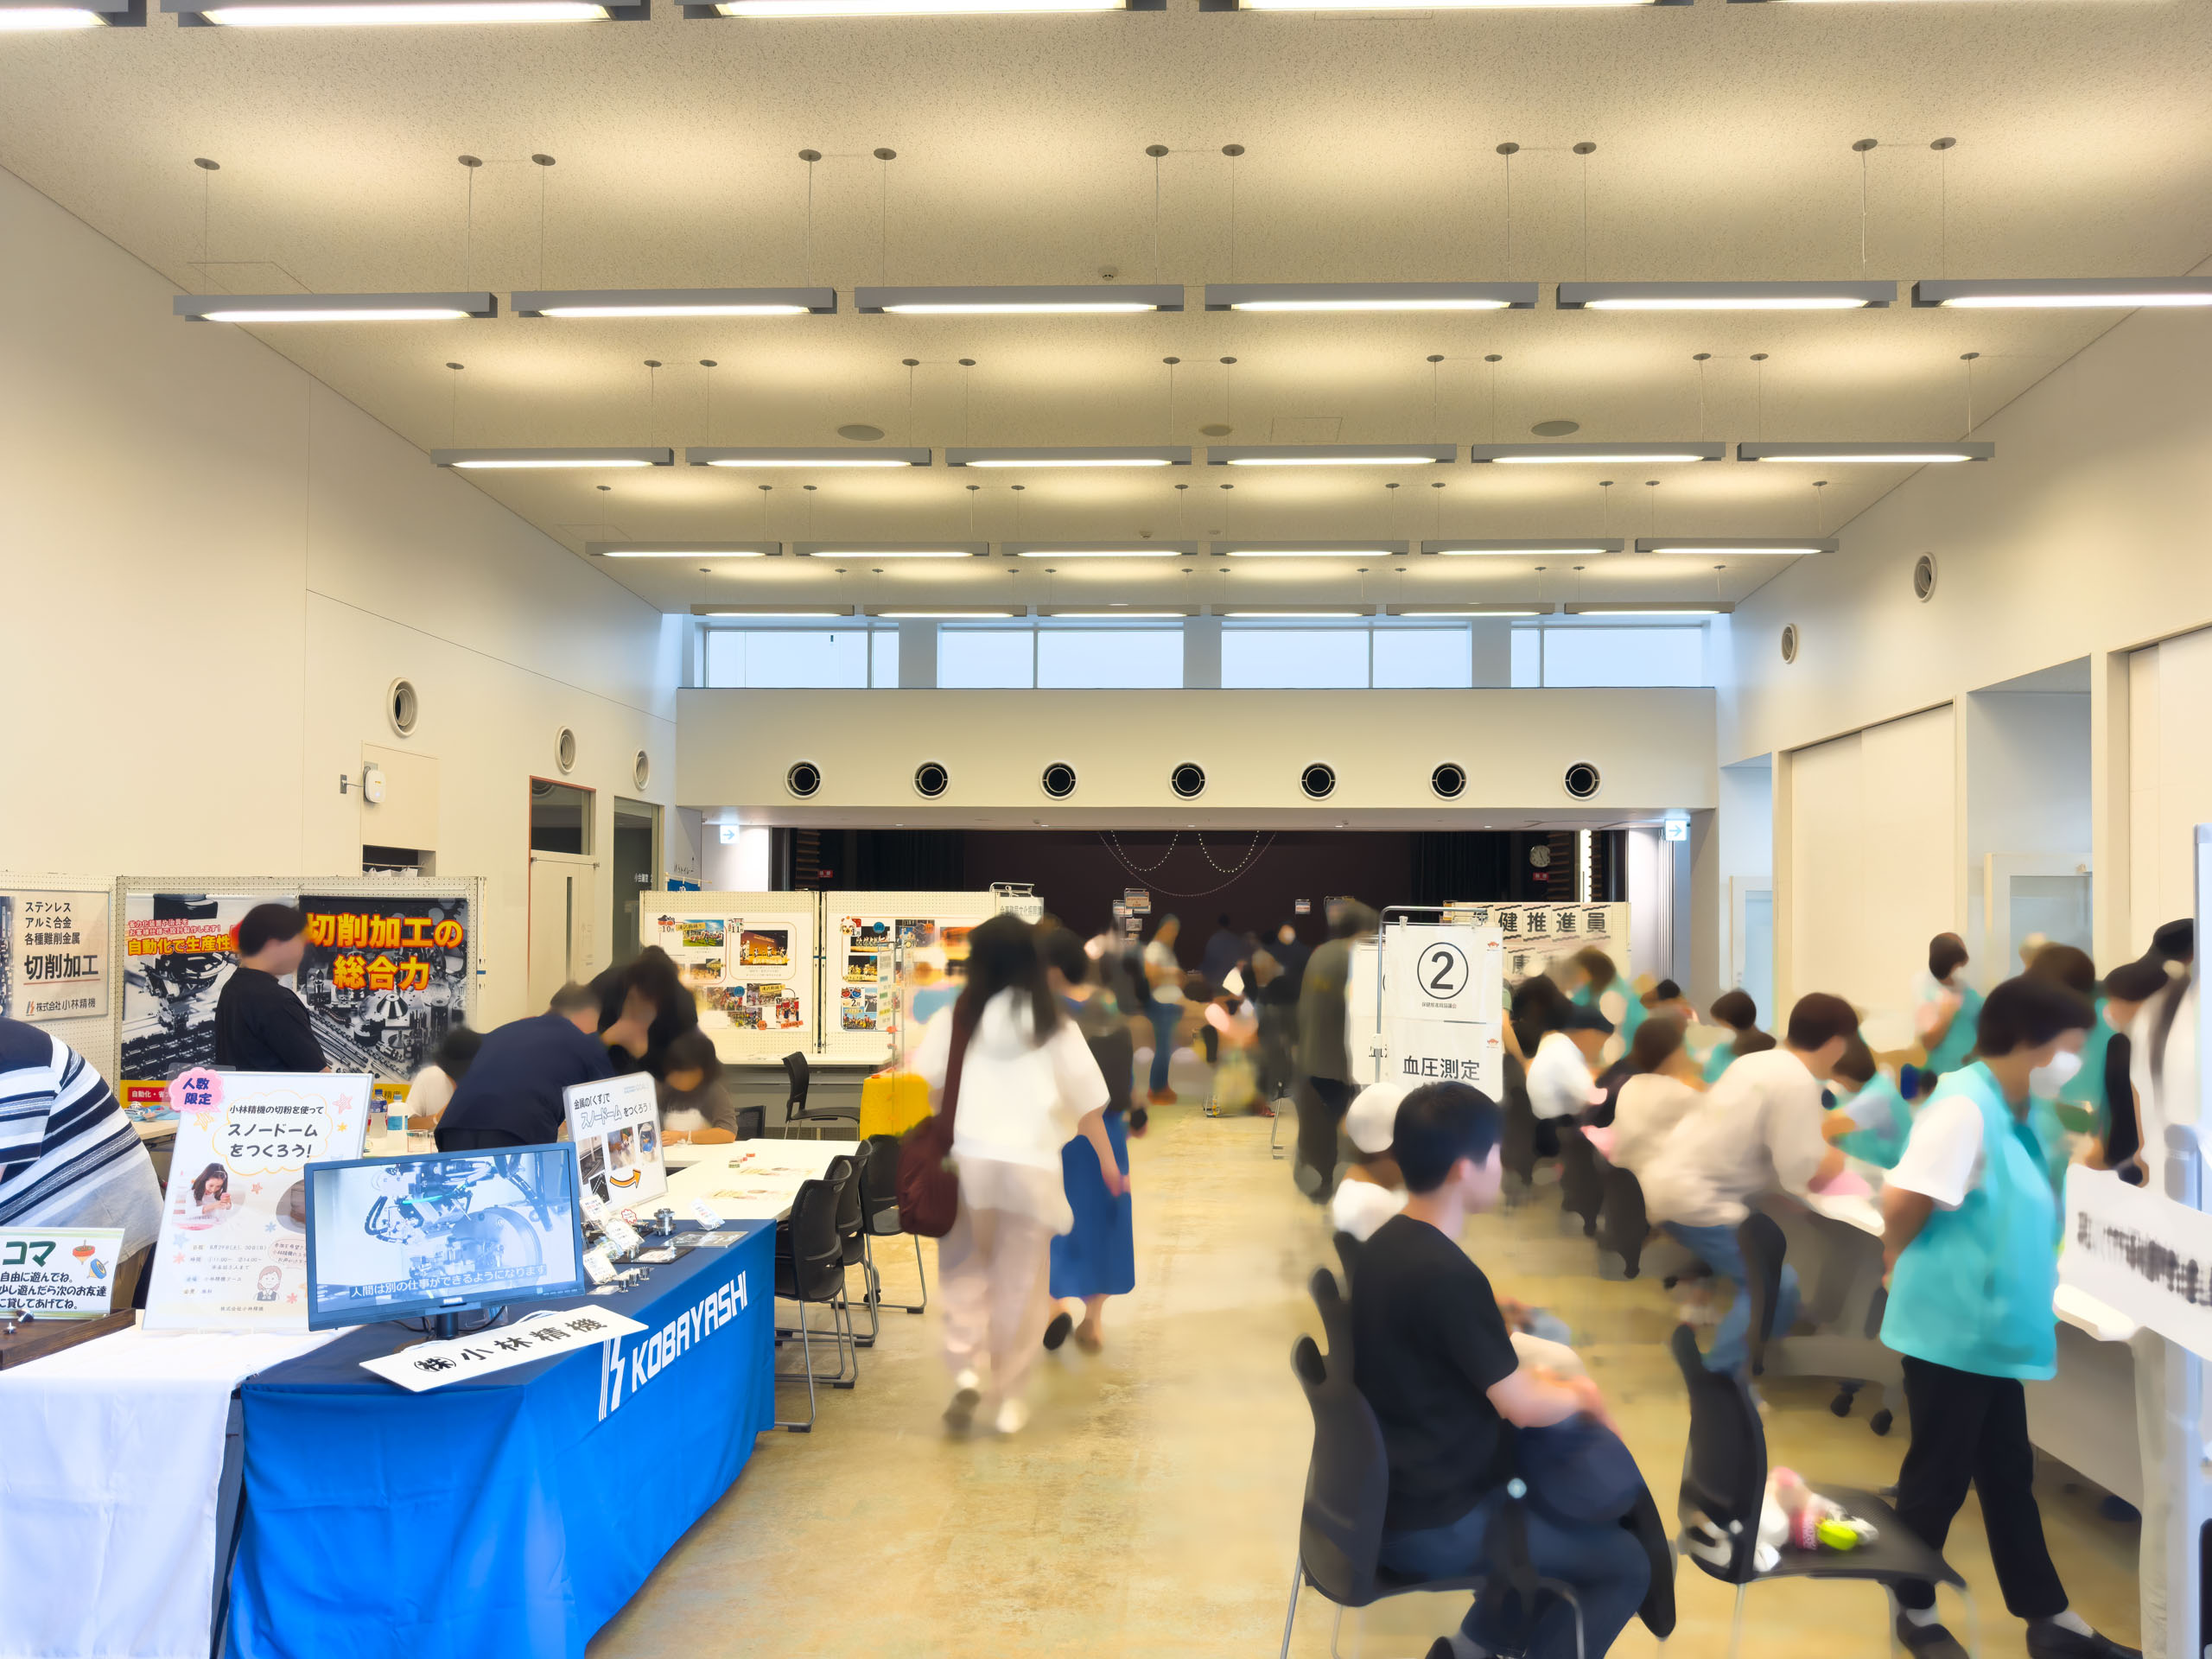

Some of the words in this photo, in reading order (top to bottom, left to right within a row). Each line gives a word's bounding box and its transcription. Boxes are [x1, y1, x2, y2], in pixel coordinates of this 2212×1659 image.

[25, 901, 72, 913] ステンレス
[25, 916, 72, 929] アルミ合金
[306, 912, 464, 949] 切削加工の
[25, 932, 80, 945] 各種難削金属
[24, 953, 99, 980] 切削加工
[333, 954, 430, 991] 総合力
[35, 998, 96, 1012] 株式会社小林精機
[1402, 1055, 1480, 1081] 血圧測定
[182, 1077, 210, 1091] 人数
[184, 1092, 213, 1106] 限定
[229, 1104, 325, 1116] 小林精機の切粉を使って
[227, 1123, 319, 1138] スノードーム
[2, 1240, 57, 1268] コマ
[632, 1270, 748, 1393] KOBAYASHI
